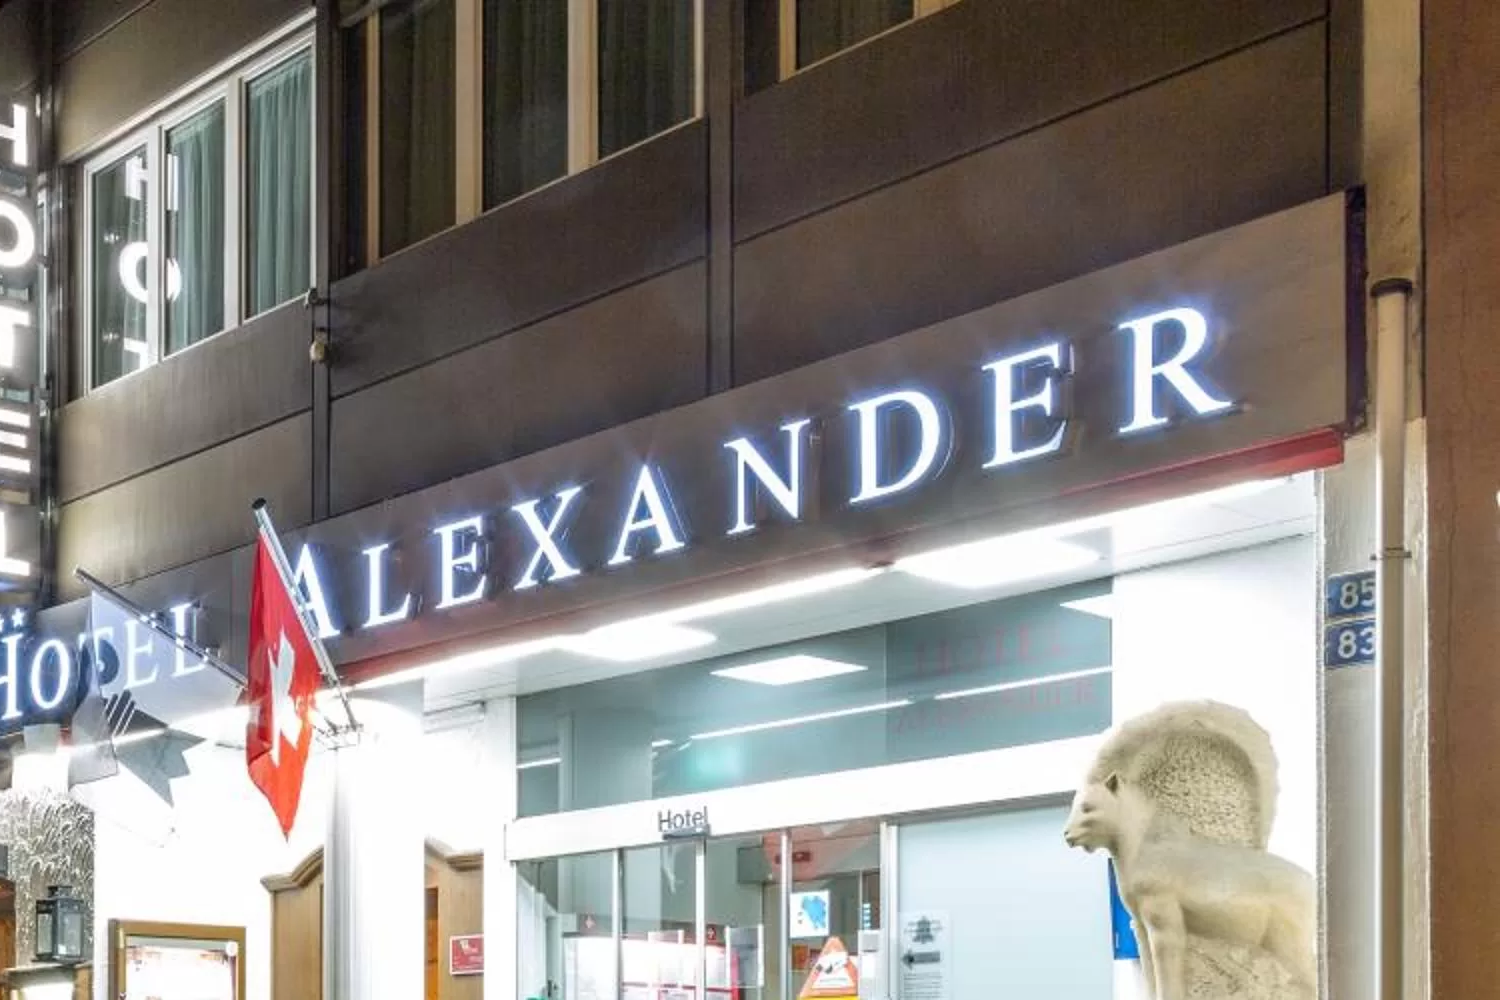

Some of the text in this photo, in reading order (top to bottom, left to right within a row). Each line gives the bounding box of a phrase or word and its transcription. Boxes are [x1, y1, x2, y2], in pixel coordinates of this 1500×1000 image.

[294, 307, 1233, 638] ALEXANDER
[1339, 577, 1377, 610] 85
[1338, 626, 1377, 660] 83
[657, 805, 709, 832] Hotel
